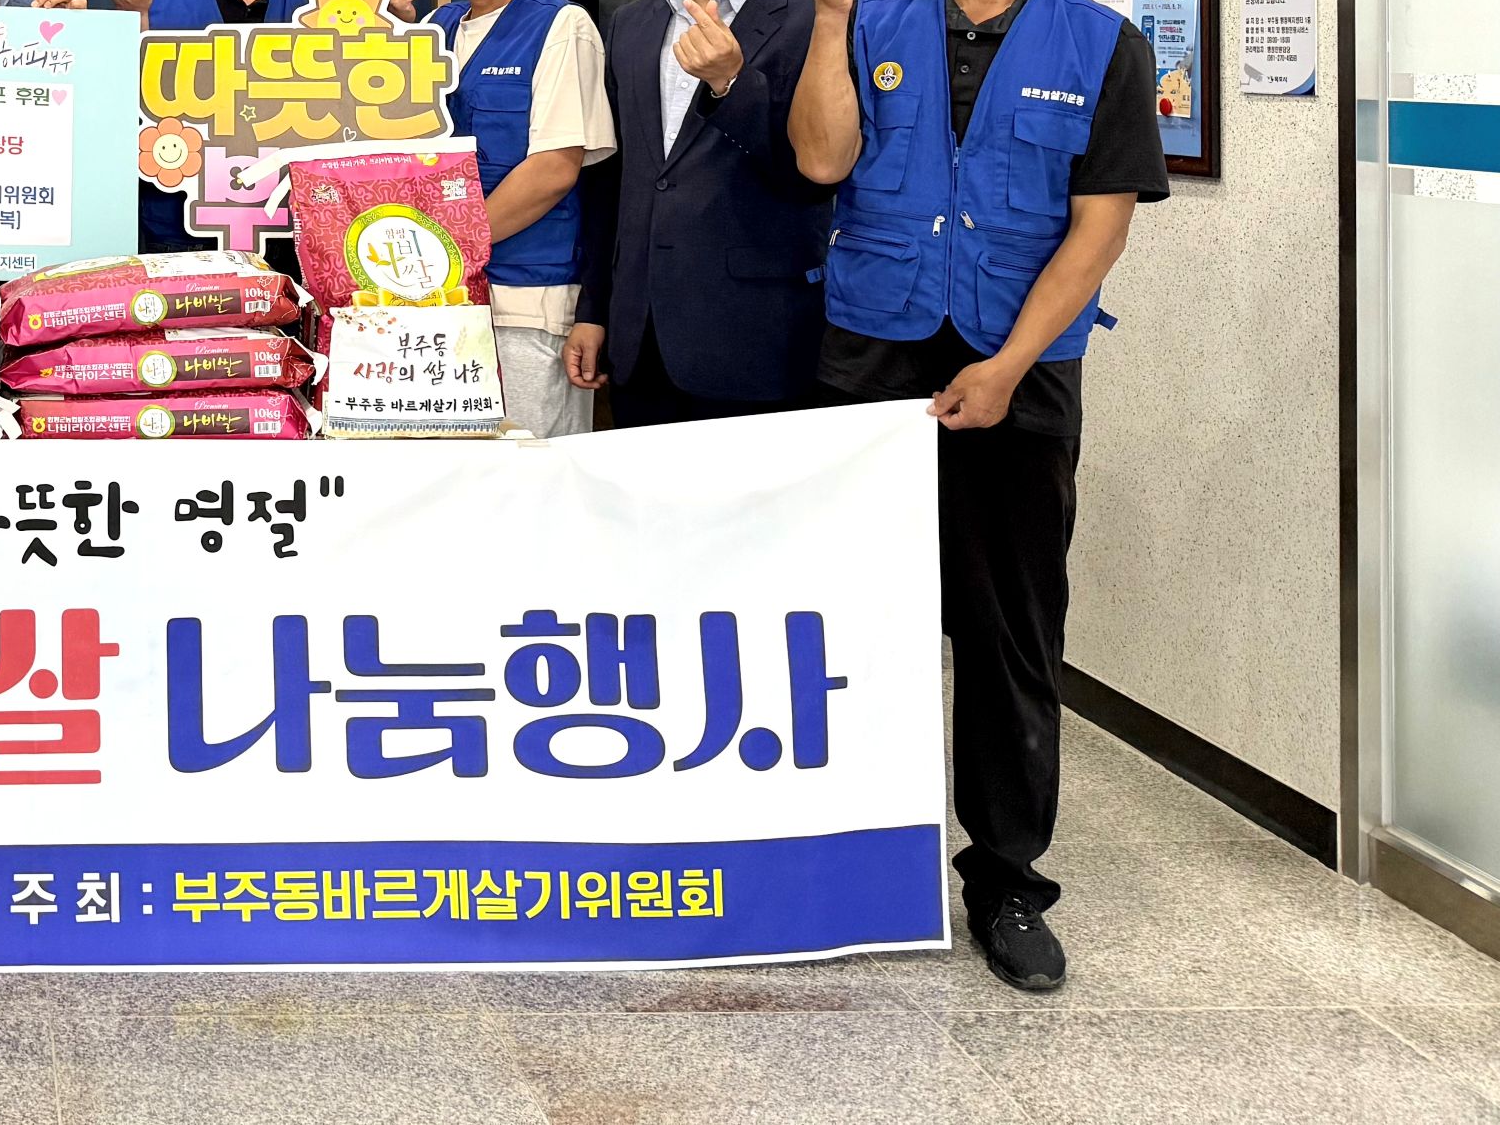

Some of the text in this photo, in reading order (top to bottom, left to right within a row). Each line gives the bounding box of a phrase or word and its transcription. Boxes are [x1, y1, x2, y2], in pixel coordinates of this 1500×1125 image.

[15, 86, 51, 106] 후원
[140, 32, 449, 143] 따뜻한
[1021, 87, 1085, 107] 바르게살기운동
[244, 288, 271, 299] 10kg
[175, 294, 234, 315] 나비쌀
[44, 309, 127, 328] 나비라이스센터
[397, 332, 448, 359] 부주동
[254, 351, 281, 362] 10kg
[184, 357, 243, 379] 나비쌀
[353, 359, 484, 386] 사랑의 쌀 나눔
[253, 408, 281, 420] 10kg
[345, 396, 493, 413] 부주동 바르게살기 위원회
[47, 422, 132, 433] 나비라이스센터
[183, 412, 243, 434] 나비쌀
[166, 610, 848, 780] 나눔행사
[172, 868, 725, 922] 부주동바르게살기위원회
